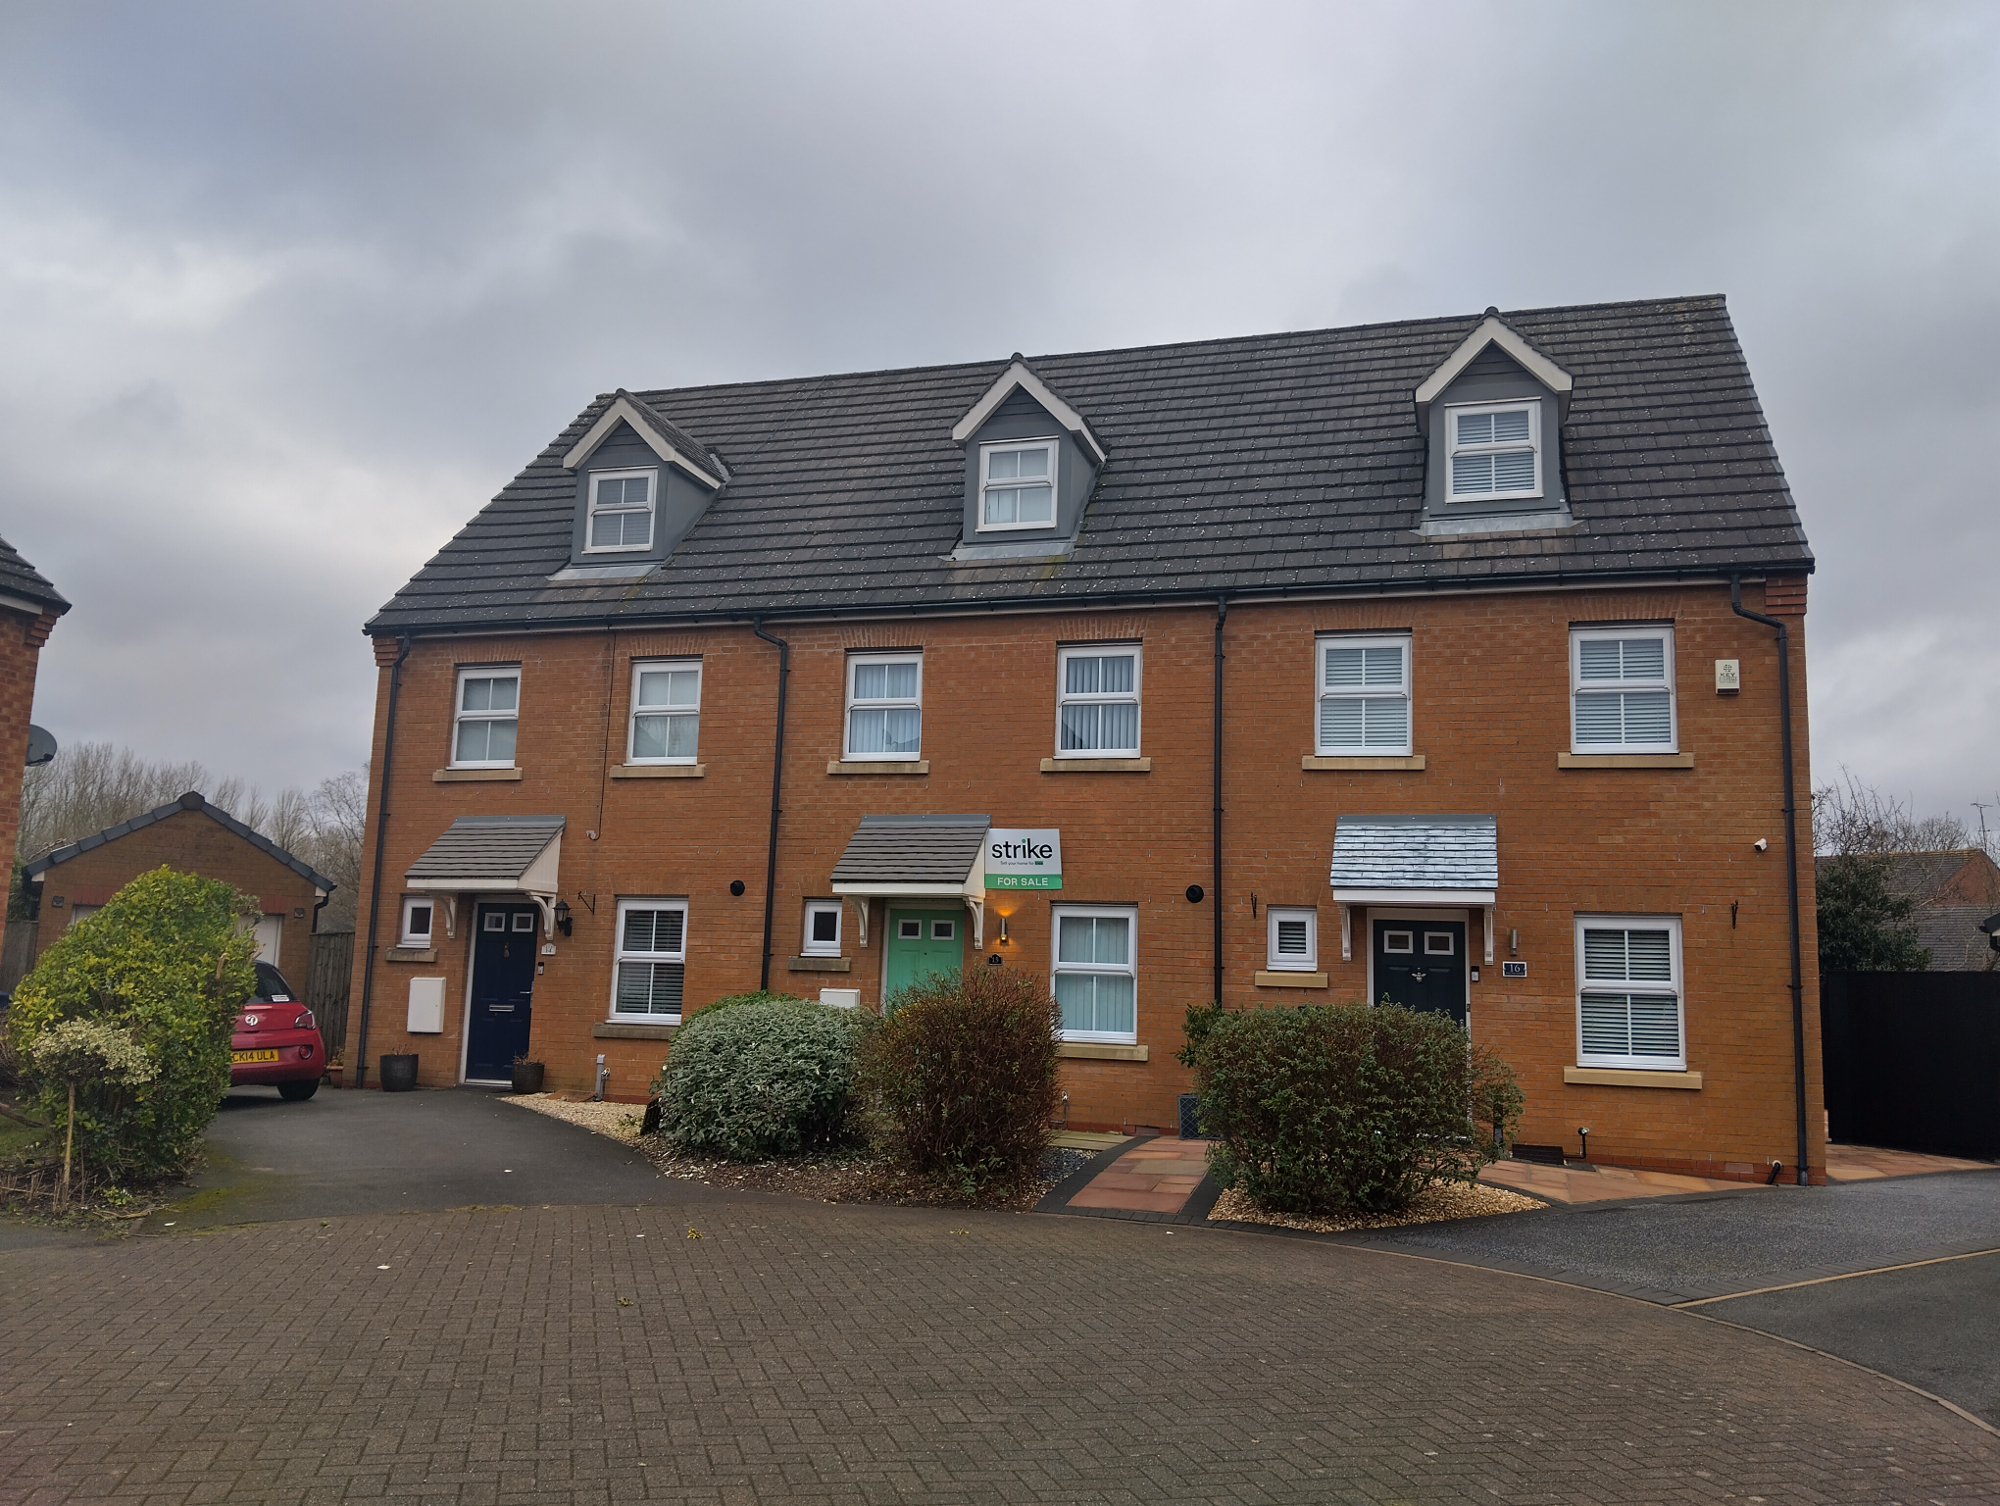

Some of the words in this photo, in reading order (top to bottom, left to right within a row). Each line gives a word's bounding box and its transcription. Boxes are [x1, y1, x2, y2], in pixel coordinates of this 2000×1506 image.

[992, 838, 1053, 859] strike
[997, 877, 1018, 886] FOR
[1020, 877, 1049, 886] SALE
[1510, 963, 1521, 973] 16
[232, 1051, 255, 1062] CK14
[256, 1050, 276, 1061] ULA
